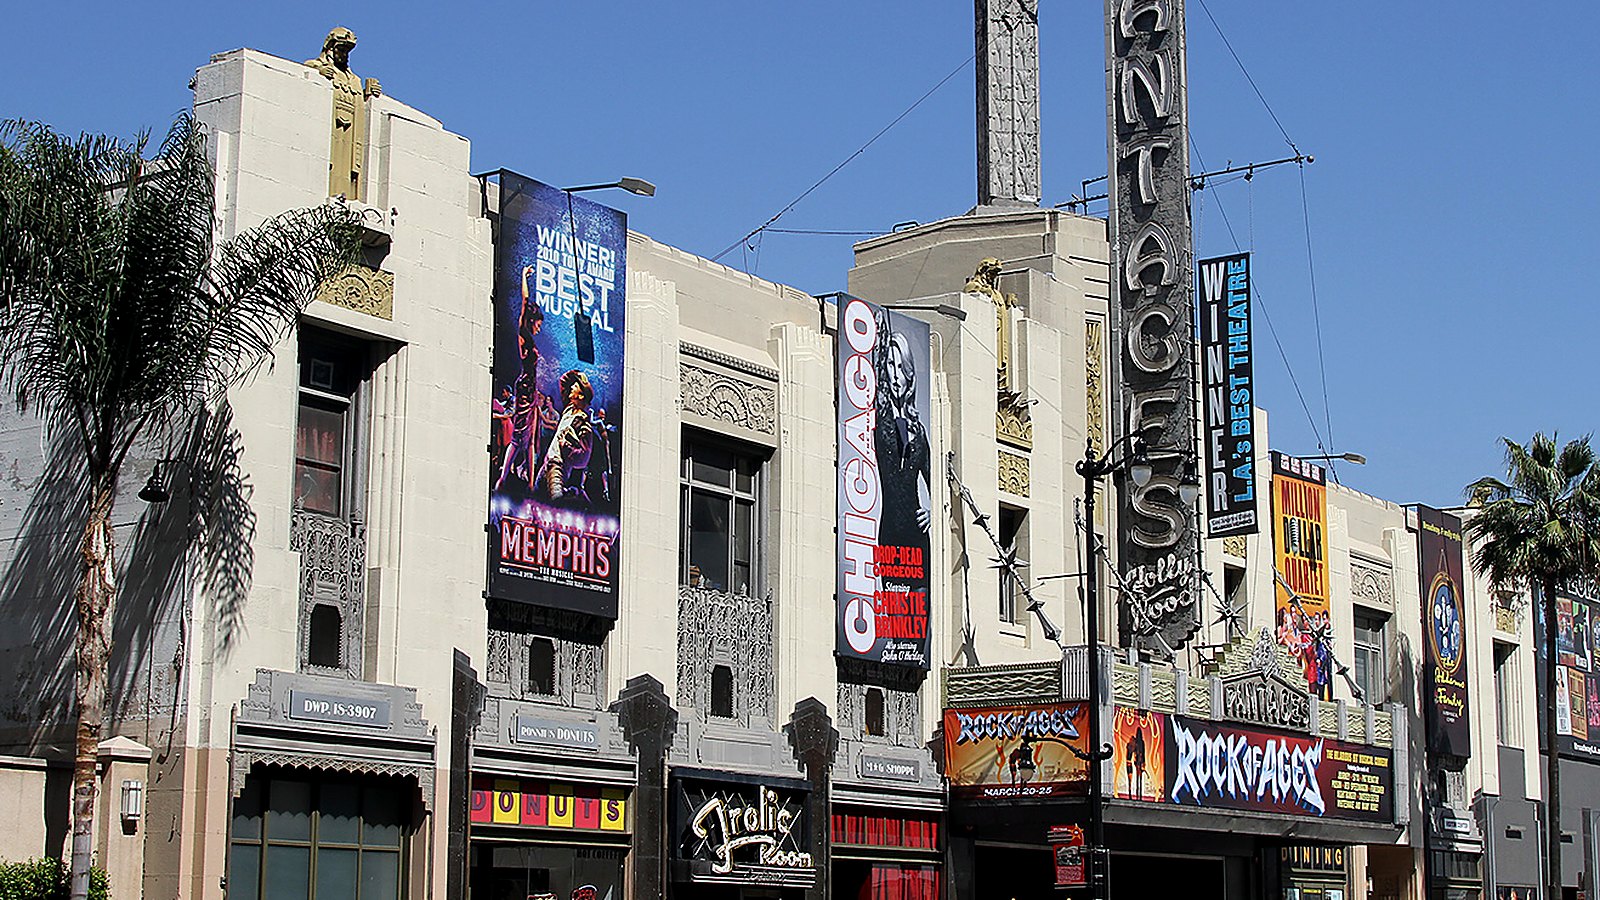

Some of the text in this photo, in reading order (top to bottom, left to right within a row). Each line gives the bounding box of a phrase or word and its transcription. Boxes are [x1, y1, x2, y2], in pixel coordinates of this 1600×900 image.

[536, 224, 615, 268] WINNER!
[537, 245, 560, 263] 2010
[587, 263, 615, 283] AWARD
[535, 259, 615, 313] BEST
[1227, 259, 1249, 371] THEATRE
[1202, 261, 1229, 512] WINNER
[1230, 374, 1251, 437] BEST
[844, 299, 877, 655] CHICAGO
[1281, 479, 1321, 523] MILLION
[501, 519, 611, 578] MEMPHIS
[873, 545, 923, 566] DROP-DEAD
[873, 565, 924, 579] GORGEOUS
[1284, 556, 1324, 597] QUARTET
[874, 589, 927, 615] CHRISTIE
[875, 616, 927, 639] BRINKLEY
[955, 709, 1013, 746] ROCK
[1022, 703, 1081, 740] AGES
[1226, 682, 1310, 725] PANTAGES
[557, 728, 595, 744] DONUTS
[1171, 714, 1326, 817] ROCK OF AGES
[471, 790, 621, 822] DONUTS
[984, 786, 1053, 797] MARCH 20-25
[692, 785, 793, 874] Frolic
[1281, 846, 1342, 865] DINING
